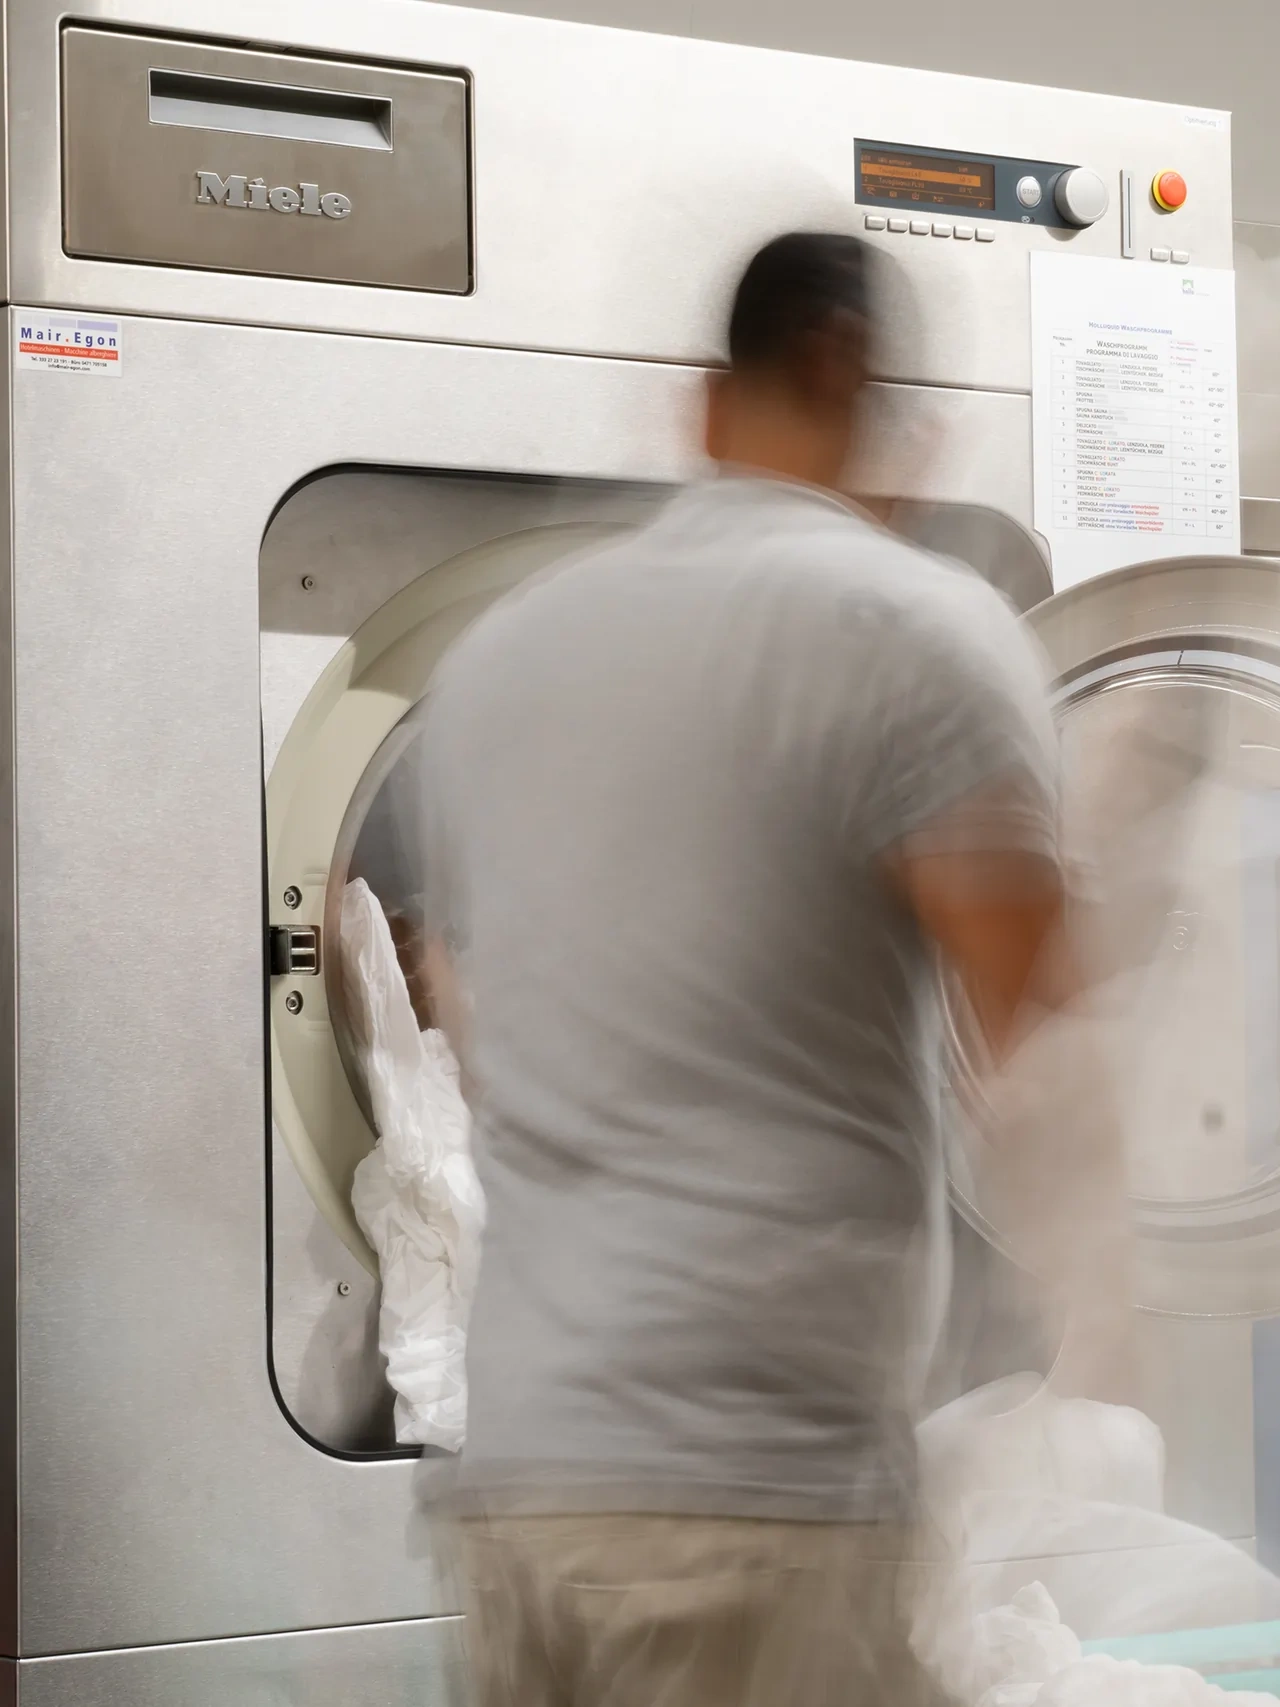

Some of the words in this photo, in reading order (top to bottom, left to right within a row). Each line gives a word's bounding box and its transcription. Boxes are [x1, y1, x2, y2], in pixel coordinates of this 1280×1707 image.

[196, 171, 351, 219] Miele
[20, 343, 60, 353] Hotelmaschinen
[64, 348, 88, 356] Macchine
[89, 350, 117, 358] alberghiere
[1097, 340, 1148, 351] WASCHPROGRAMM
[1086, 349, 1122, 358] PROGRAMMA
[1130, 352, 1158, 360] LAVAGGIO
